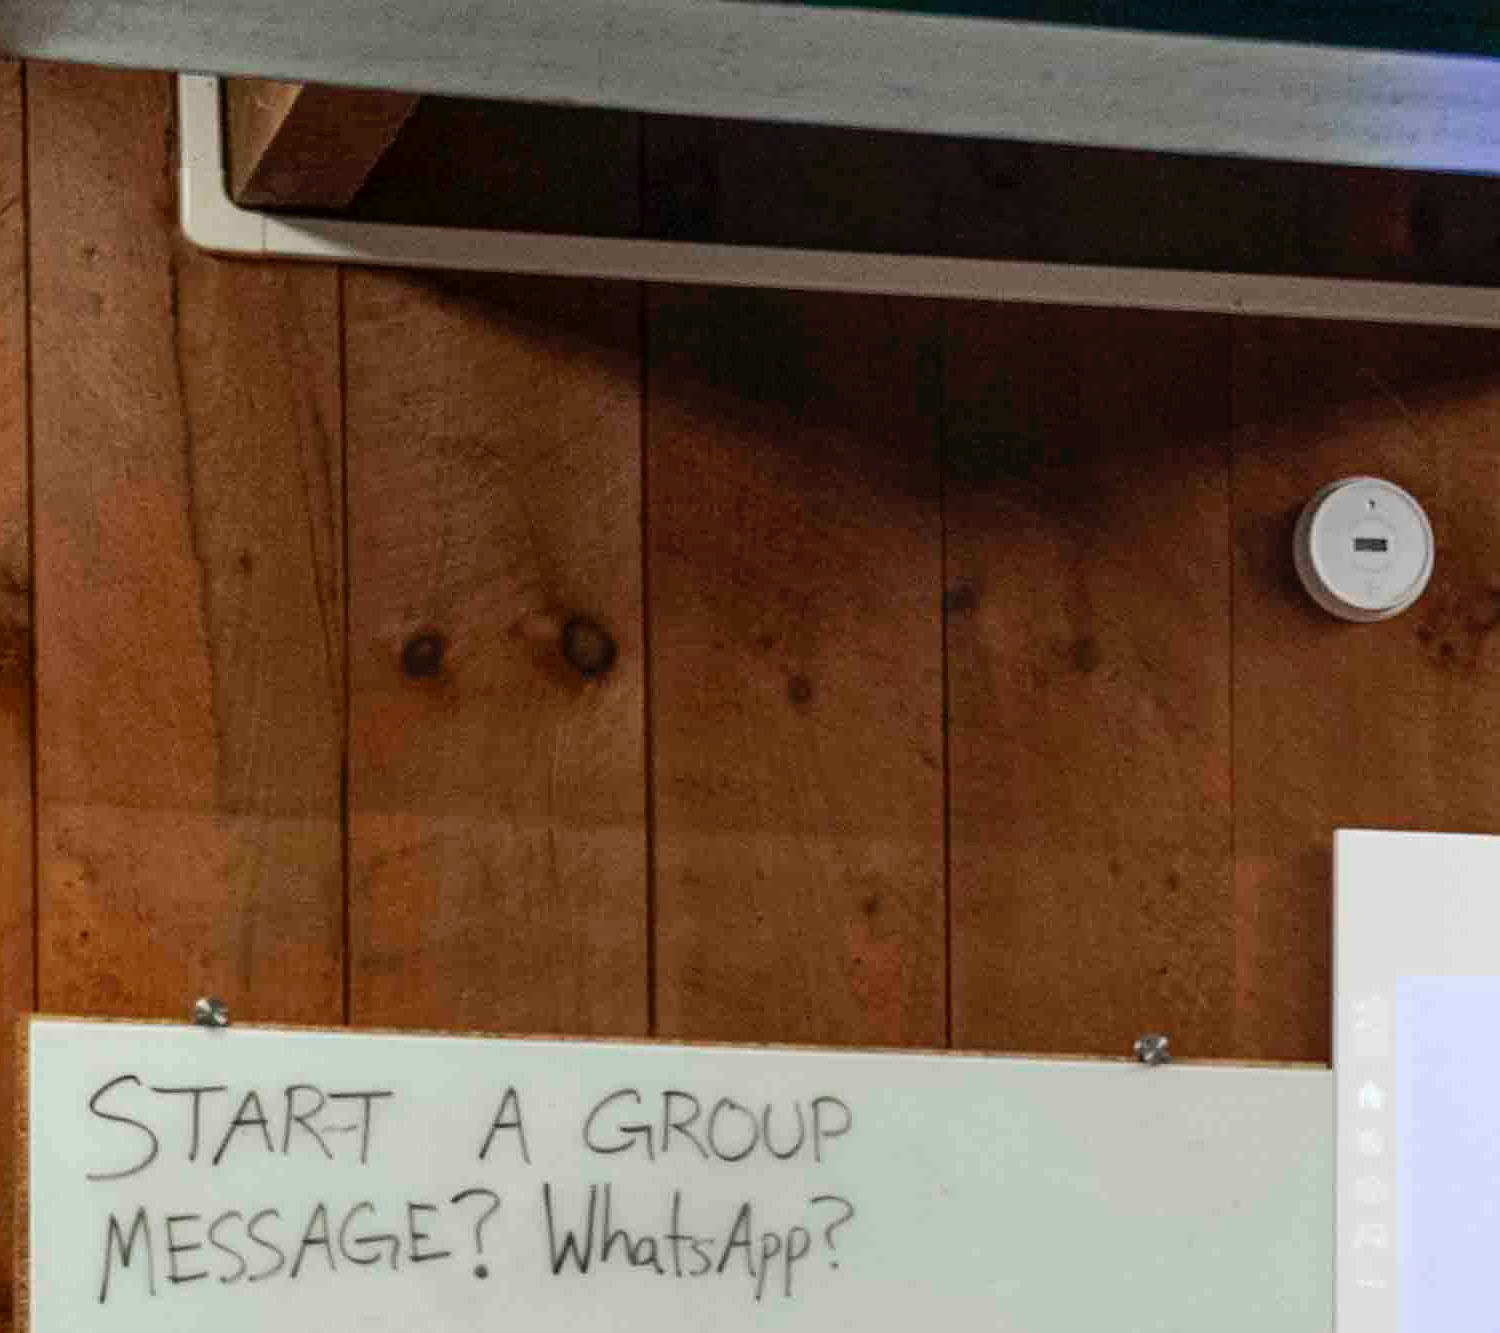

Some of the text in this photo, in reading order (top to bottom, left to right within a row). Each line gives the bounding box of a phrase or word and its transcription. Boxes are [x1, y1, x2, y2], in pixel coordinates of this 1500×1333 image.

[86, 1073, 853, 1181] START A GROUP
[99, 1182, 855, 1304] MESSAGE? WhatsApp?
